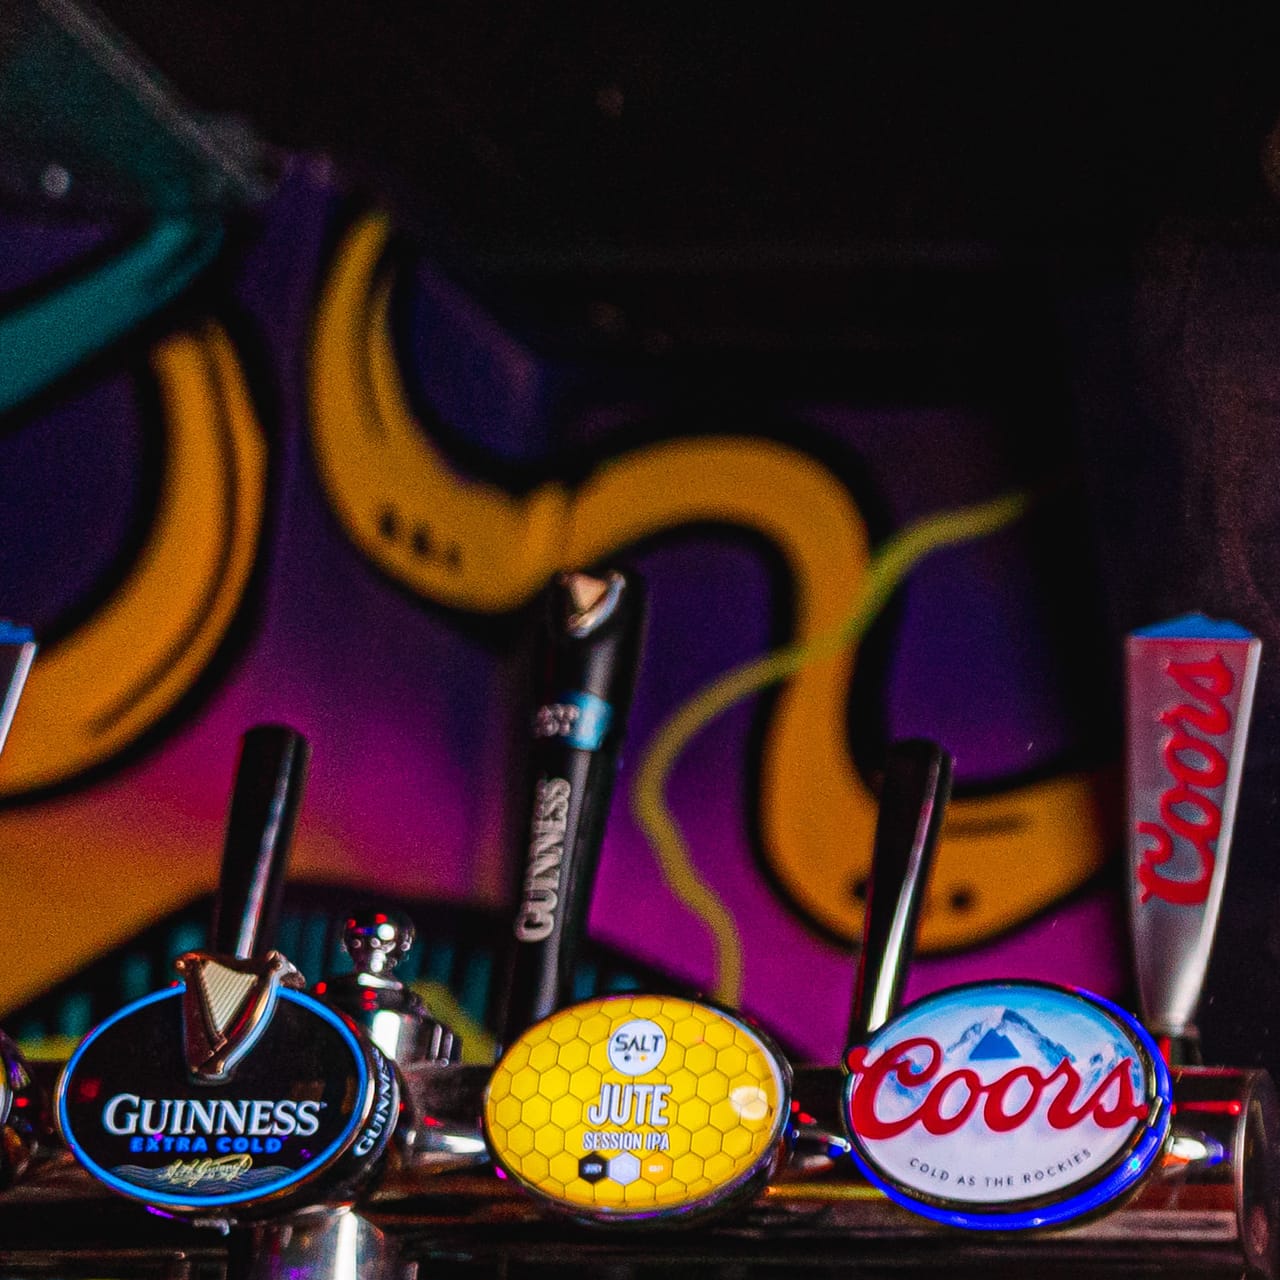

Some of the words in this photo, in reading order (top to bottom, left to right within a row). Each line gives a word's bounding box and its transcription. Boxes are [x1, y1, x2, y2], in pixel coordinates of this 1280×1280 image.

[1135, 653, 1234, 906] Coors
[614, 1034, 664, 1052] SALT
[587, 1083, 673, 1127] JUTE
[846, 1036, 1150, 1141] Coors
[102, 1093, 322, 1137] GUINNESS
[129, 1136, 208, 1153] EXTRA
[215, 1136, 283, 1153] COLD
[582, 1131, 643, 1152] SESSION
[644, 1131, 670, 1152] IPA
[908, 1156, 951, 1183] COLD
[956, 1175, 978, 1188] AS
[984, 1176, 1015, 1188] THE
[1022, 1149, 1093, 1185] ROCKIES
